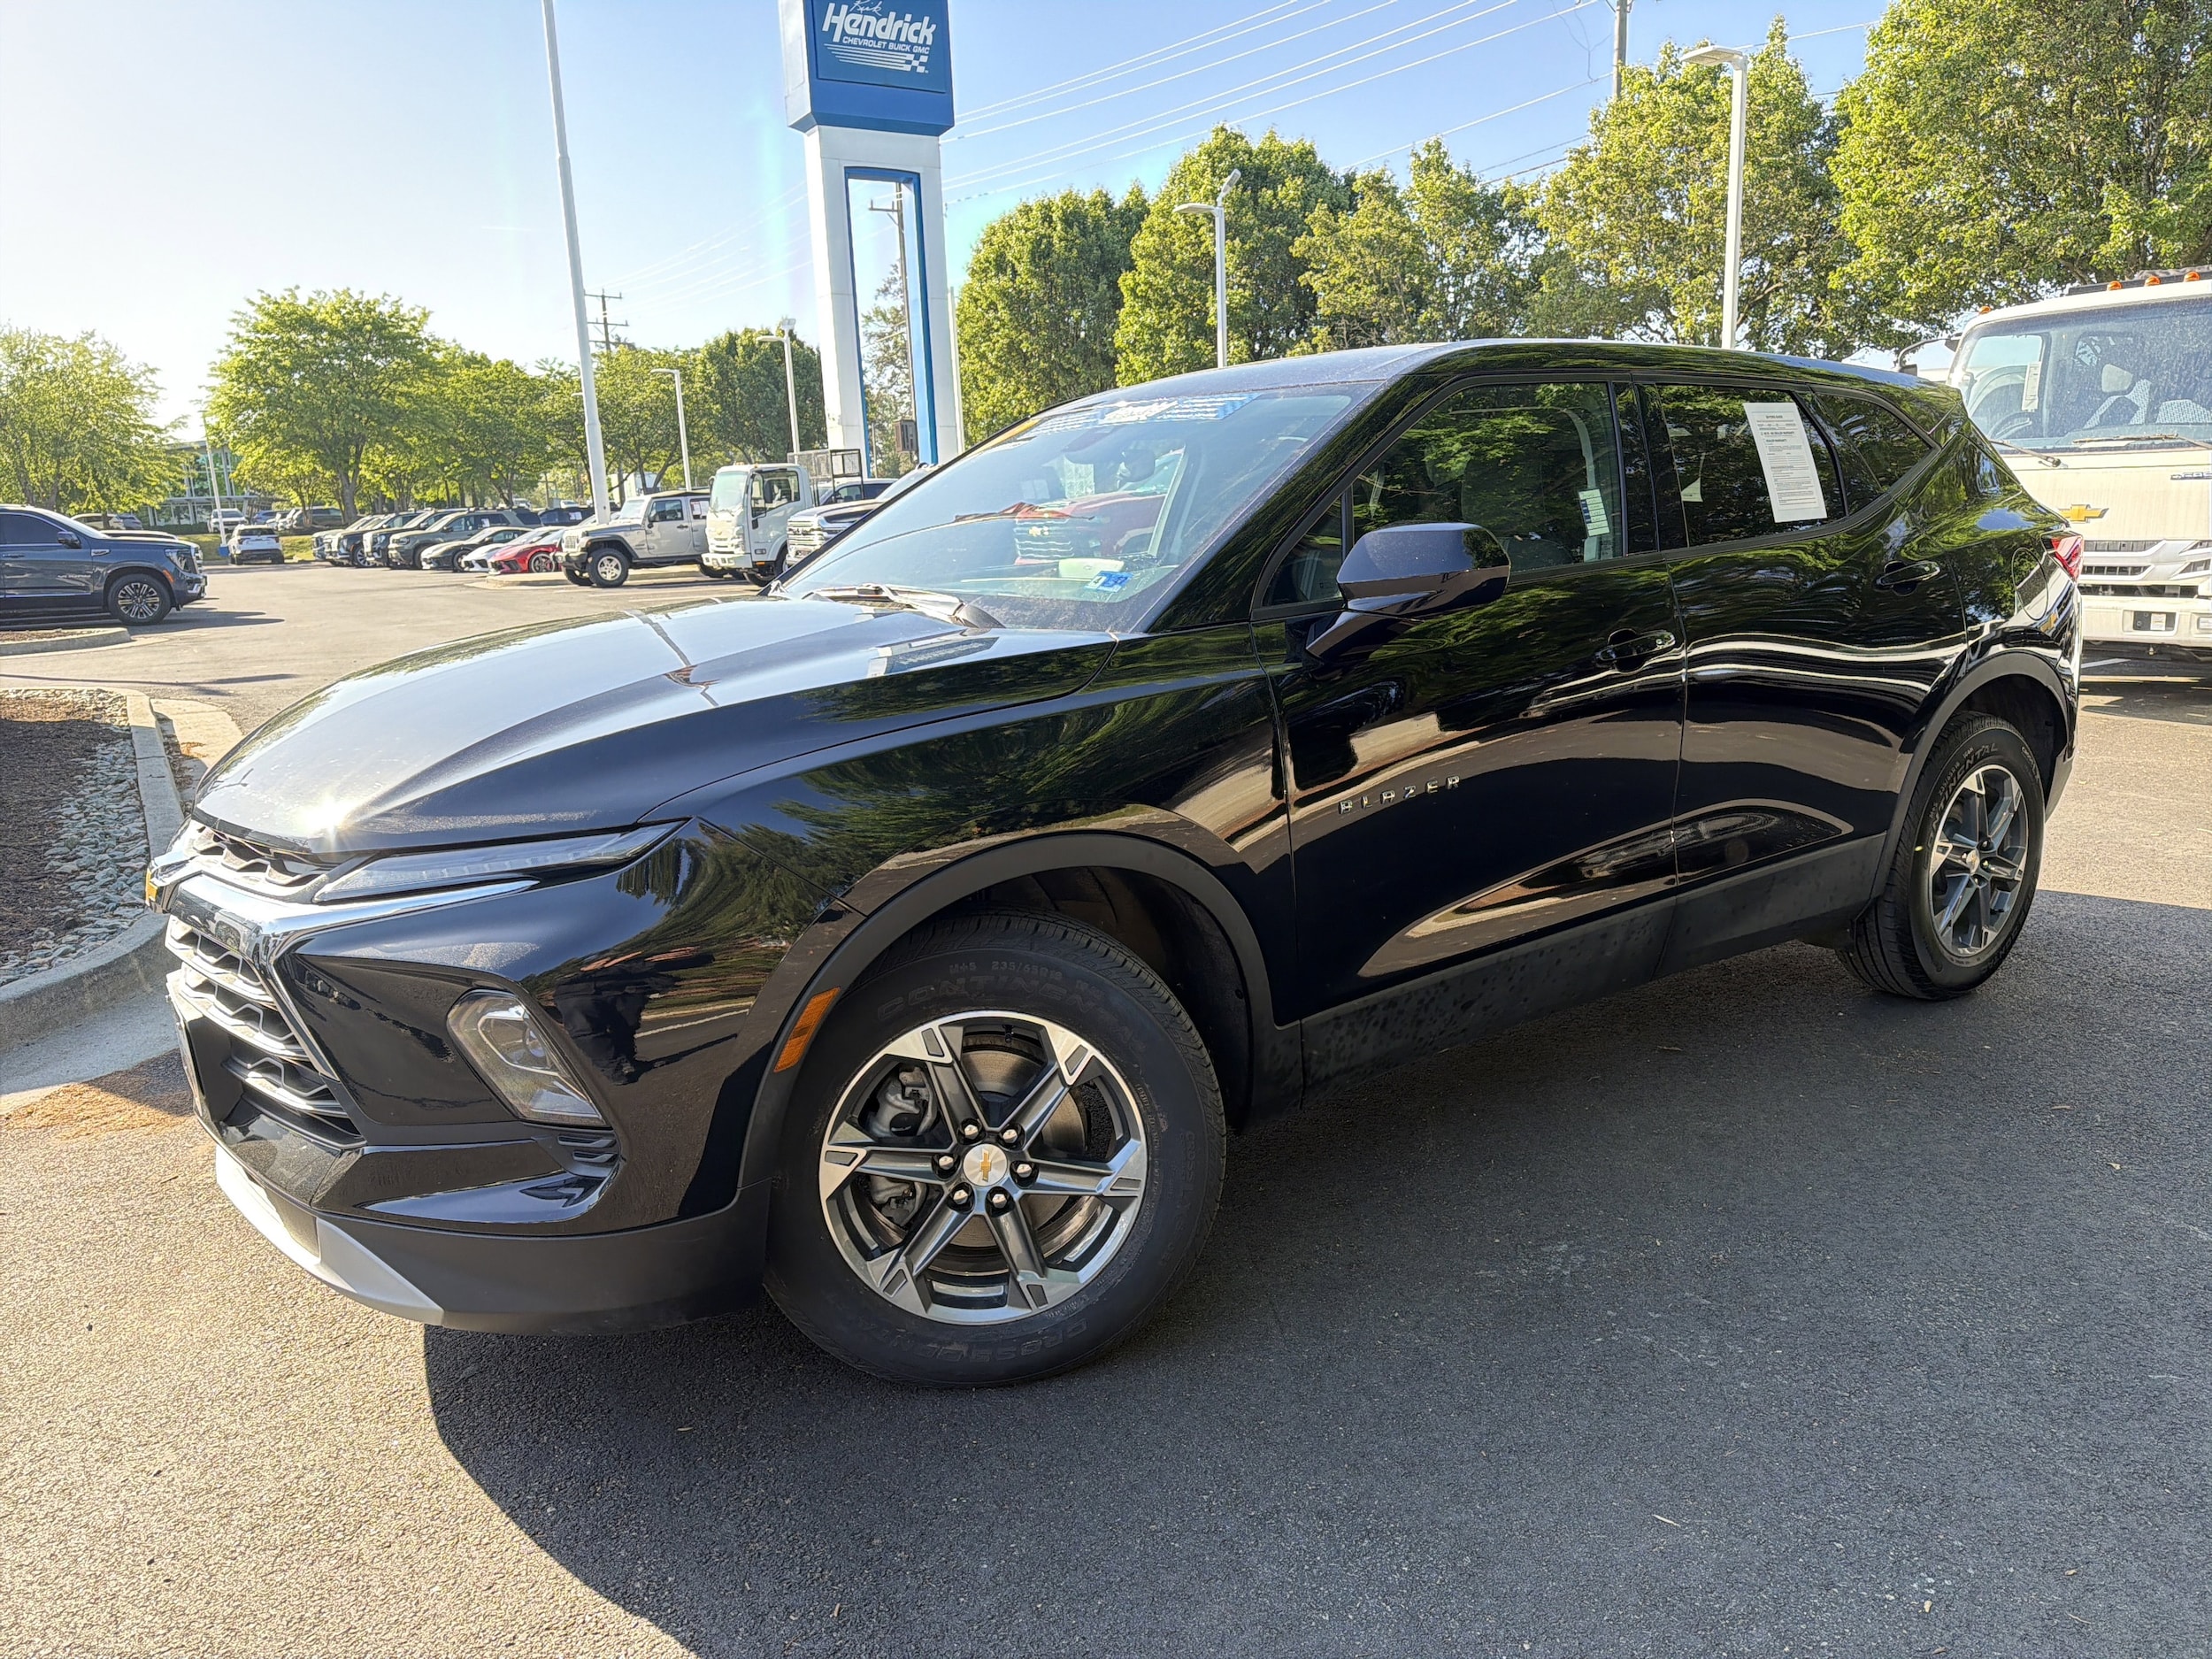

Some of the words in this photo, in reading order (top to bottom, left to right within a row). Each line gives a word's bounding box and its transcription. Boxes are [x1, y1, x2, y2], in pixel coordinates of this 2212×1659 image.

[822, 3, 937, 45] Hendrick
[842, 36, 886, 50] CHEVROLET
[888, 42, 910, 53] BUICK
[912, 45, 930, 55] GMC
[1339, 775, 1461, 815] BLAZER
